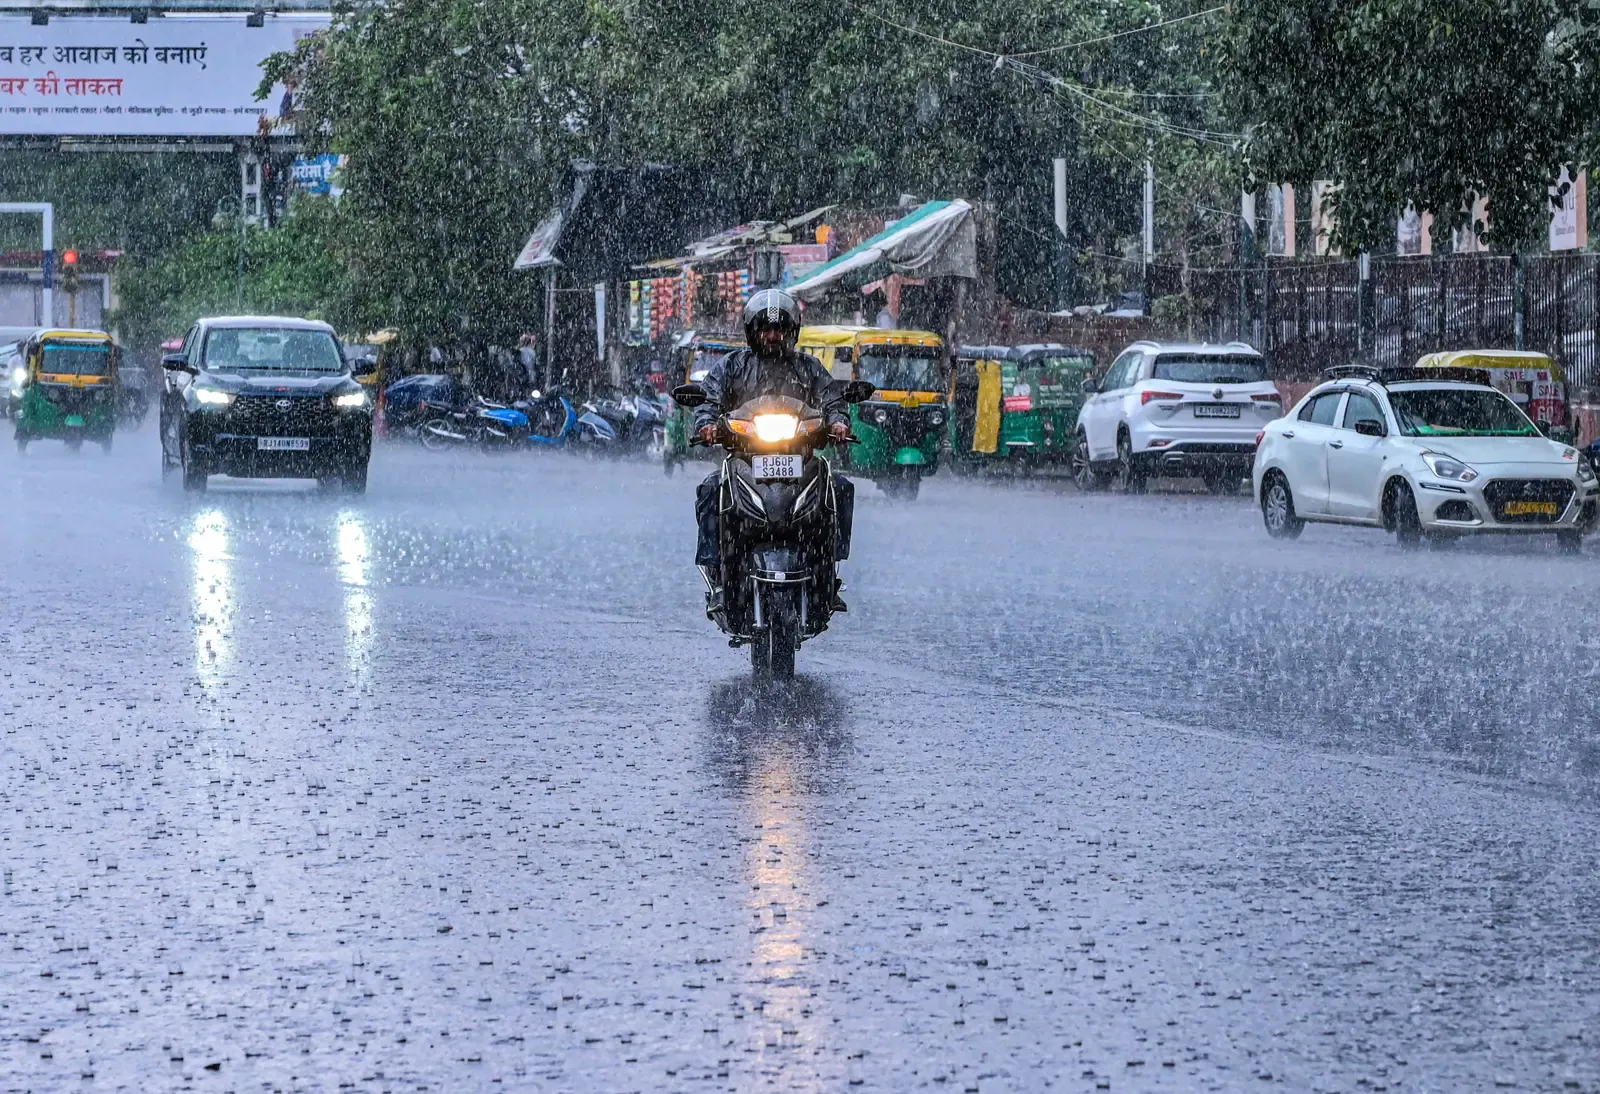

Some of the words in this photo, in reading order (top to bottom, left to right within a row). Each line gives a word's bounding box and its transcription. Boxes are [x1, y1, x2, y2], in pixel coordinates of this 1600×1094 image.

[19, 46, 48, 66] हर
[53, 46, 118, 64] आवाज
[122, 38, 149, 64] को
[153, 41, 208, 70] बनाएं
[0, 78, 29, 96] बर
[33, 70, 60, 96] की
[64, 78, 123, 96] ताकत
[1504, 371, 1525, 380] SALE
[1539, 384, 1559, 397] SALE
[762, 456, 794, 467] RJ60P
[762, 467, 794, 477] S3488
